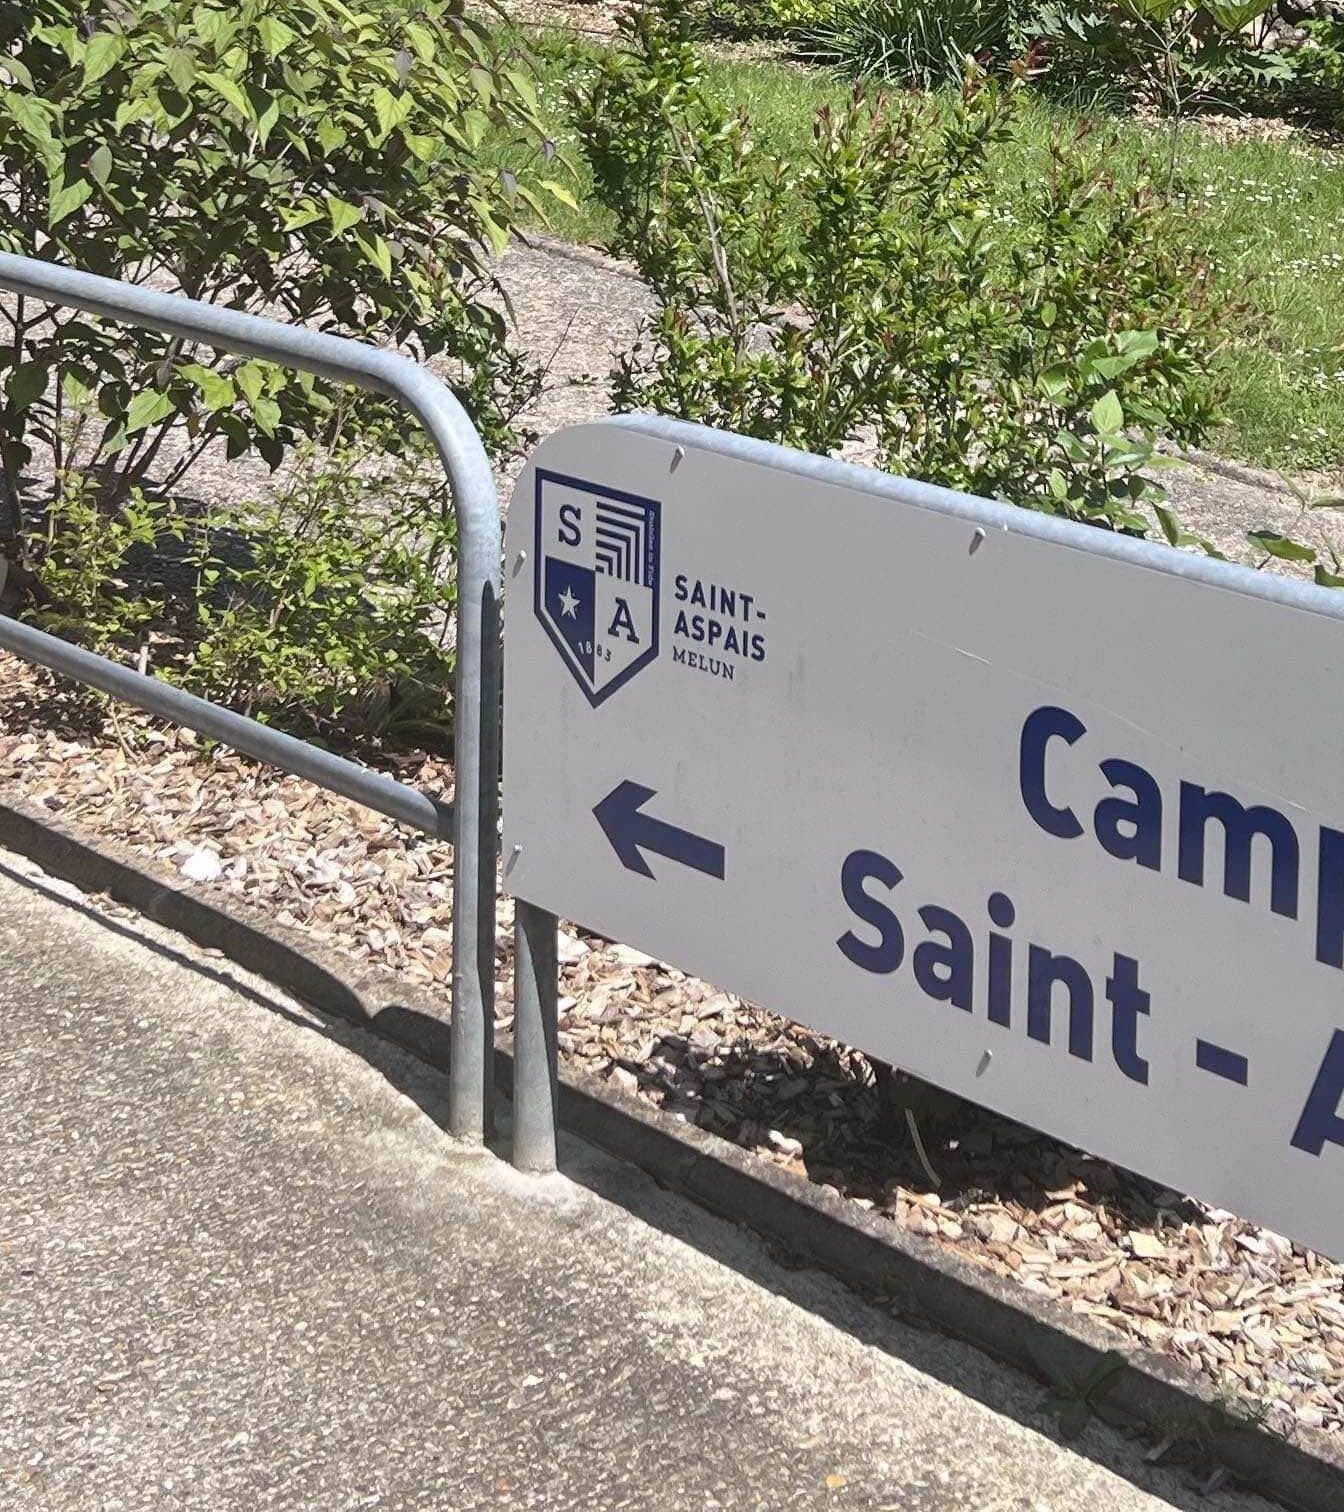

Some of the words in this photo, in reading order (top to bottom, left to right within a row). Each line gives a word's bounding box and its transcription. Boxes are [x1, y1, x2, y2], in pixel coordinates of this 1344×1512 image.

[558, 503, 582, 547] S
[607, 596, 640, 645] A
[674, 574, 767, 623] SAINT-
[577, 640, 612, 662] 1883
[673, 609, 766, 662] ASPAIS
[672, 645, 736, 681] MELUN
[835, 849, 1152, 1088] Saint
